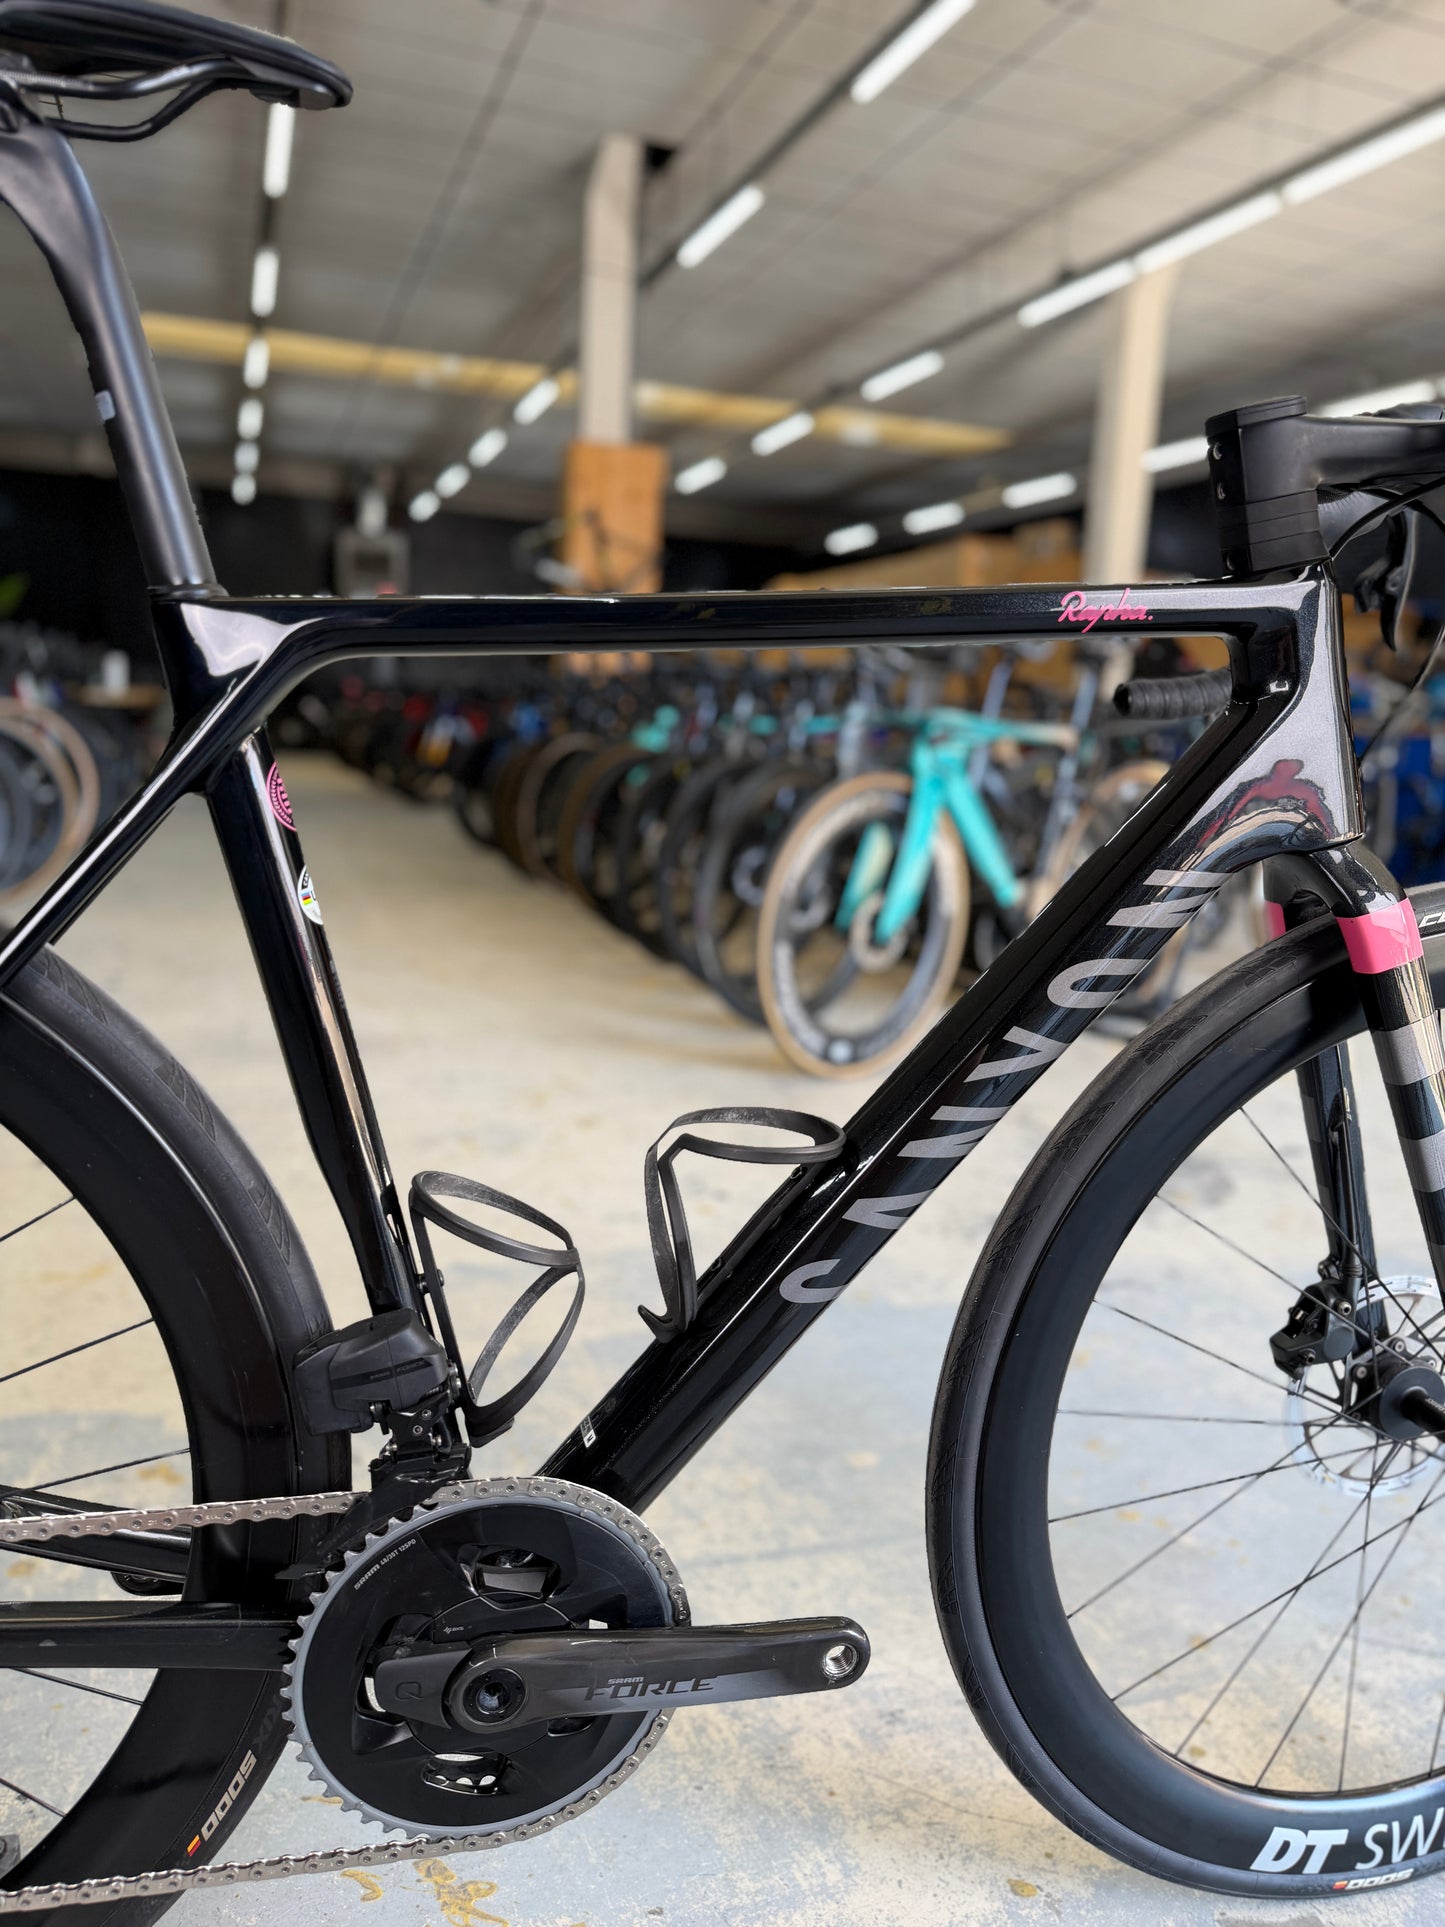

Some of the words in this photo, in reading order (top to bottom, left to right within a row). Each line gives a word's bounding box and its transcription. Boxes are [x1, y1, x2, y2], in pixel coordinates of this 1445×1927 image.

[779, 869, 1232, 1304] CANYON
[354, 1564, 380, 1590] SRAM
[584, 1679, 712, 1700] FORCE
[201, 1749, 257, 1841] 5000
[1250, 1826, 1349, 1874] DT
[1355, 1807, 1445, 1870] SW
[1346, 1868, 1414, 1890] 5000
